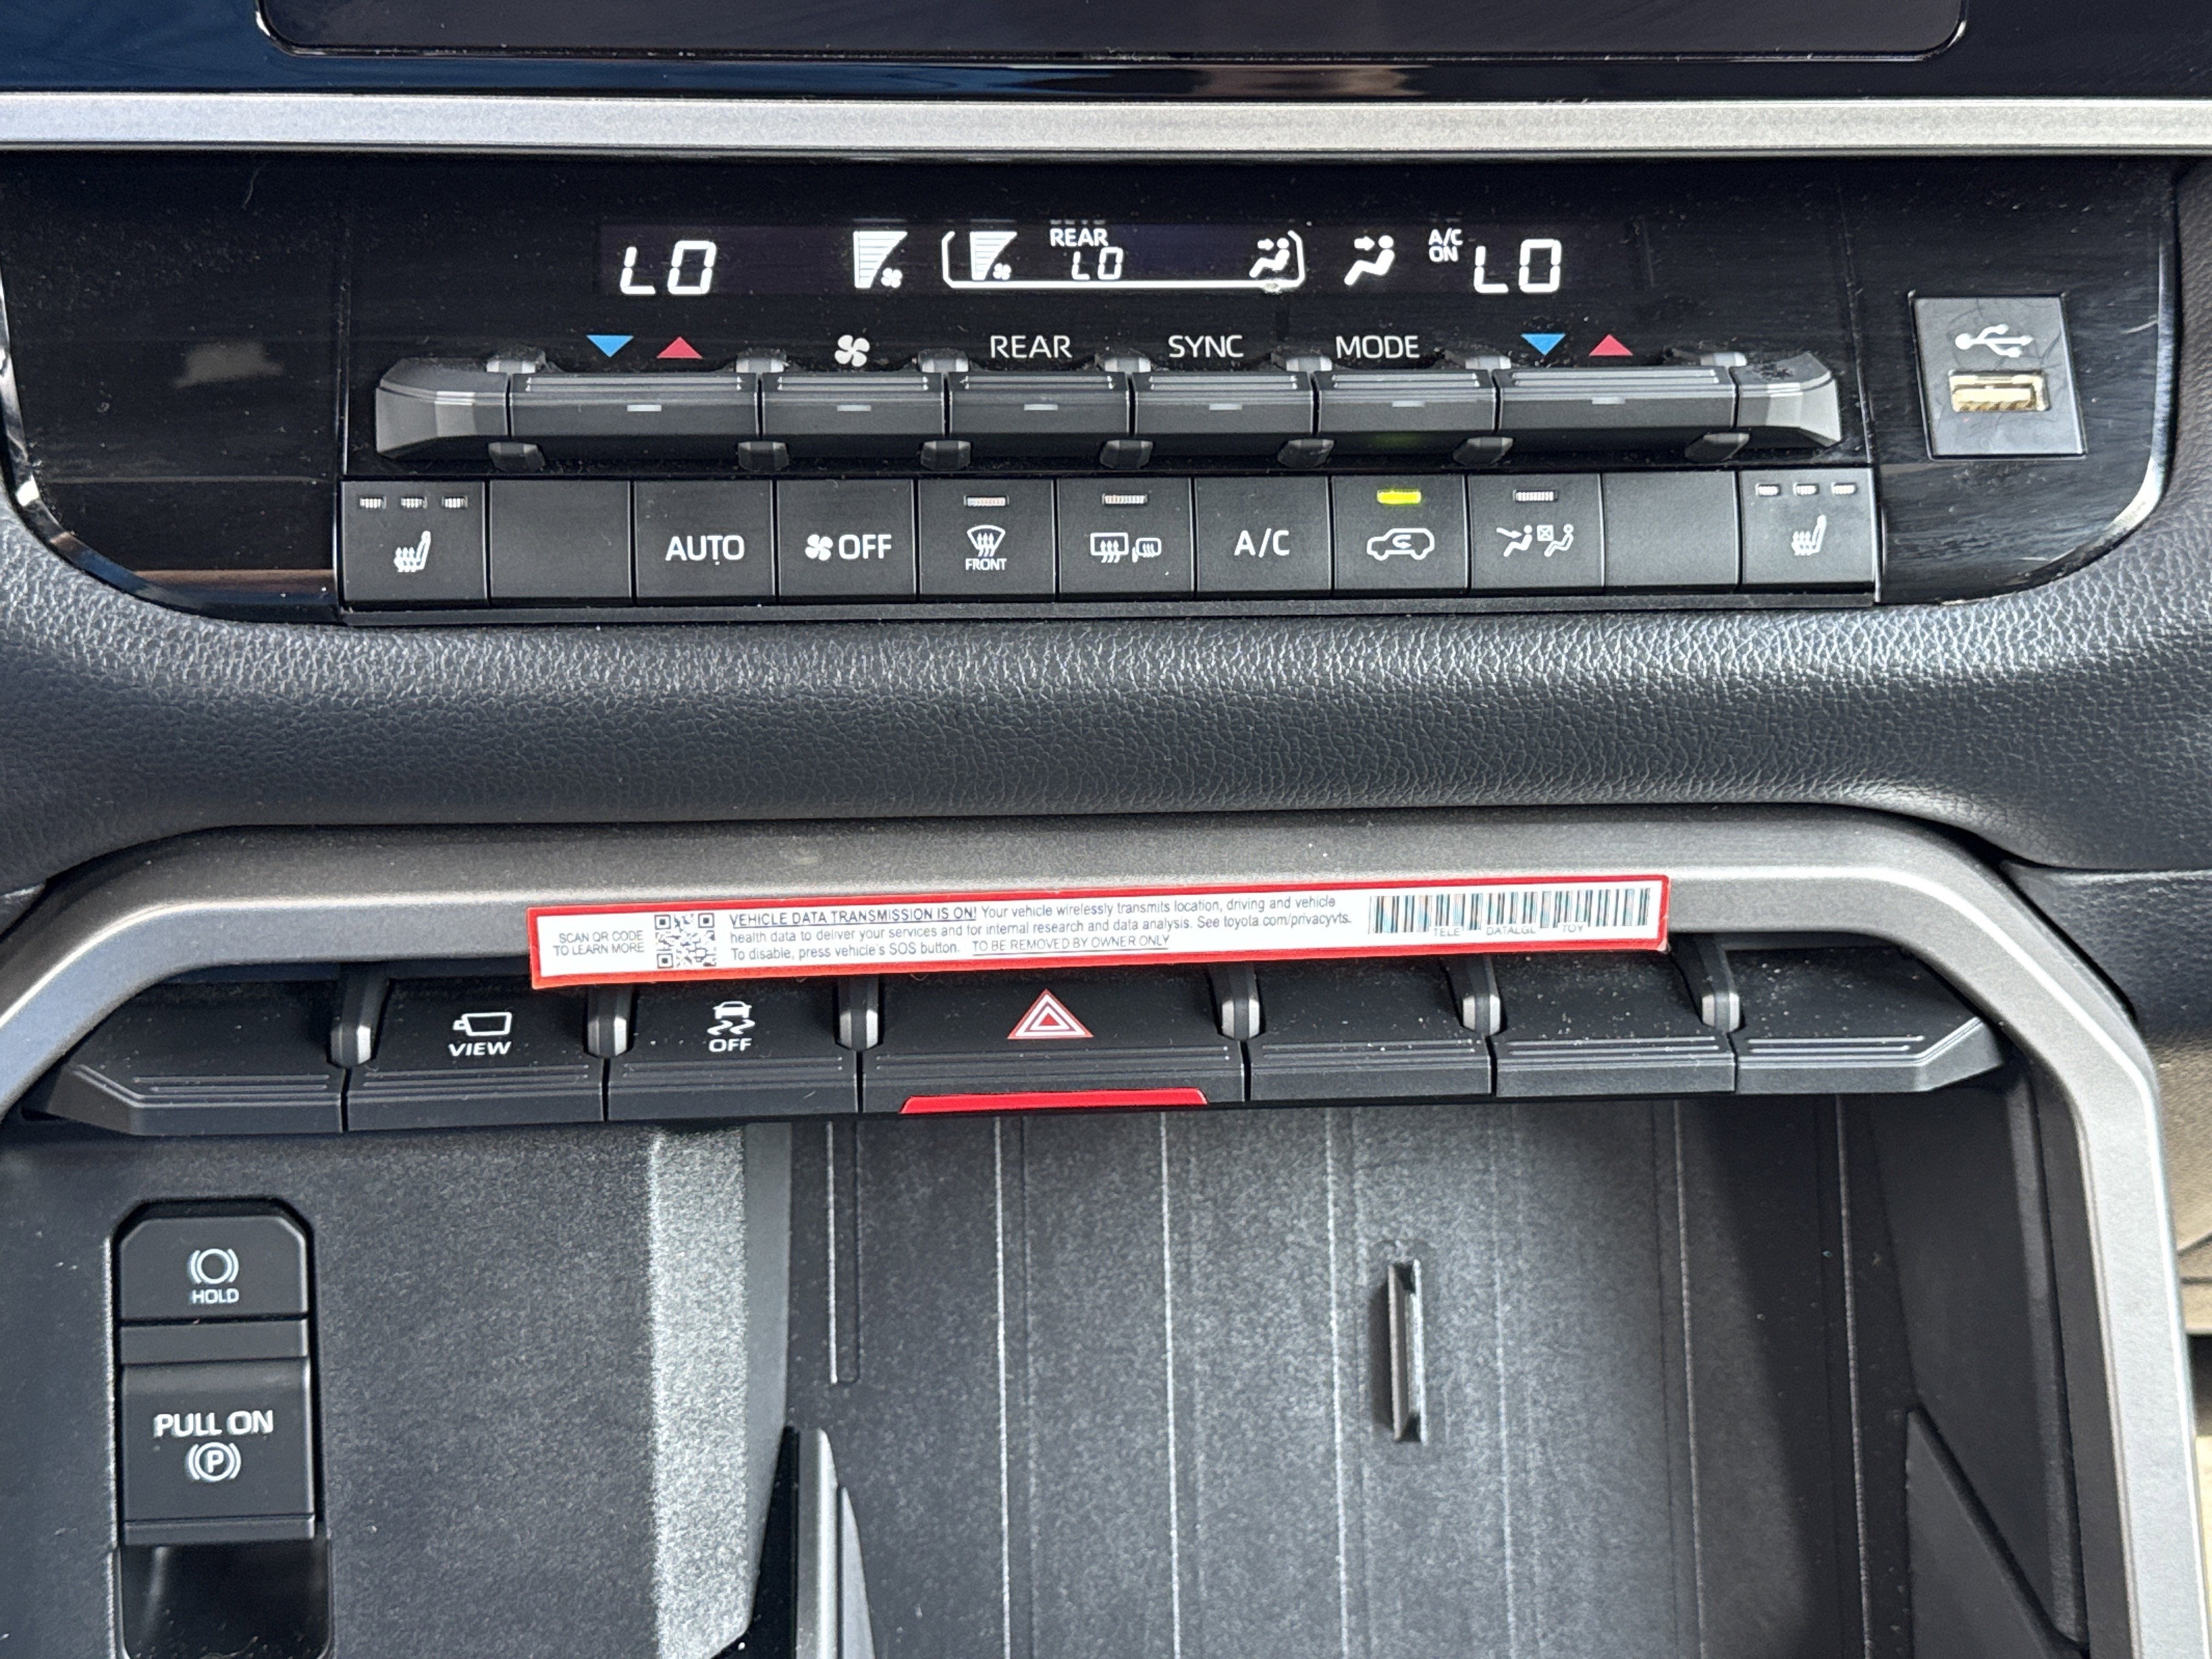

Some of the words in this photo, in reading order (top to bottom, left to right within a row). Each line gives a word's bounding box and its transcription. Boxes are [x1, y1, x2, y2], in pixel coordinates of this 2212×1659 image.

[1050, 228, 1108, 247] REAR
[1429, 228, 1463, 246] A/C
[1429, 246, 1458, 263] ON
[990, 335, 1072, 358] REAR
[1169, 335, 1244, 358] SYNC
[1336, 335, 1420, 359] MODE
[665, 535, 744, 561] AUTO
[838, 534, 891, 560] OFF
[1234, 529, 1290, 557] A/C
[966, 558, 1007, 571] FRONT
[729, 912, 787, 927] VEHICLE
[793, 911, 827, 924] DATA
[831, 907, 933, 923] TRANSMISSION
[937, 907, 949, 919] IS
[953, 906, 977, 919] ON!
[981, 905, 1008, 918] Your
[1012, 904, 1052, 917] vehicle
[1057, 902, 1114, 918] wirelessly
[1117, 900, 1170, 914] transmits
[1175, 898, 1223, 913] location,
[1226, 897, 1265, 913] driving
[1269, 896, 1291, 909] and
[1295, 894, 1335, 908] vehicle
[559, 932, 589, 944] SCAN
[612, 929, 644, 941] CODE
[730, 931, 766, 944] health
[770, 930, 796, 943] data
[800, 930, 812, 942] to
[816, 928, 855, 941] deliver
[859, 930, 885, 941] your
[888, 926, 937, 940] services
[941, 924, 962, 937] and
[967, 924, 983, 936] for
[986, 922, 1029, 935] internal
[1033, 919, 1084, 934] research
[1088, 919, 1109, 932] and
[1113, 918, 1138, 932] data
[1142, 916, 1193, 933] analysis.
[1197, 915, 1220, 928] See
[554, 945, 568, 956] TO
[572, 943, 608, 956] LEARN
[612, 941, 645, 953] MORE
[731, 947, 745, 961] To
[749, 946, 795, 960] disable,
[798, 947, 831, 961] press
[834, 943, 885, 958] vehicle's
[889, 941, 917, 956] SOS
[920, 940, 960, 955] button.
[972, 939, 988, 952] TO
[991, 939, 1006, 952] BE
[1010, 937, 1070, 951] REMOVED
[1073, 936, 1088, 949] BY
[1091, 934, 1136, 948] OWNER
[1139, 933, 1170, 947] ONLY
[449, 1041, 512, 1057] VIEW
[708, 1039, 752, 1052] OFF
[190, 1288, 239, 1304] HOLD
[153, 1413, 222, 1438] PULL
[226, 1409, 274, 1435] ON
